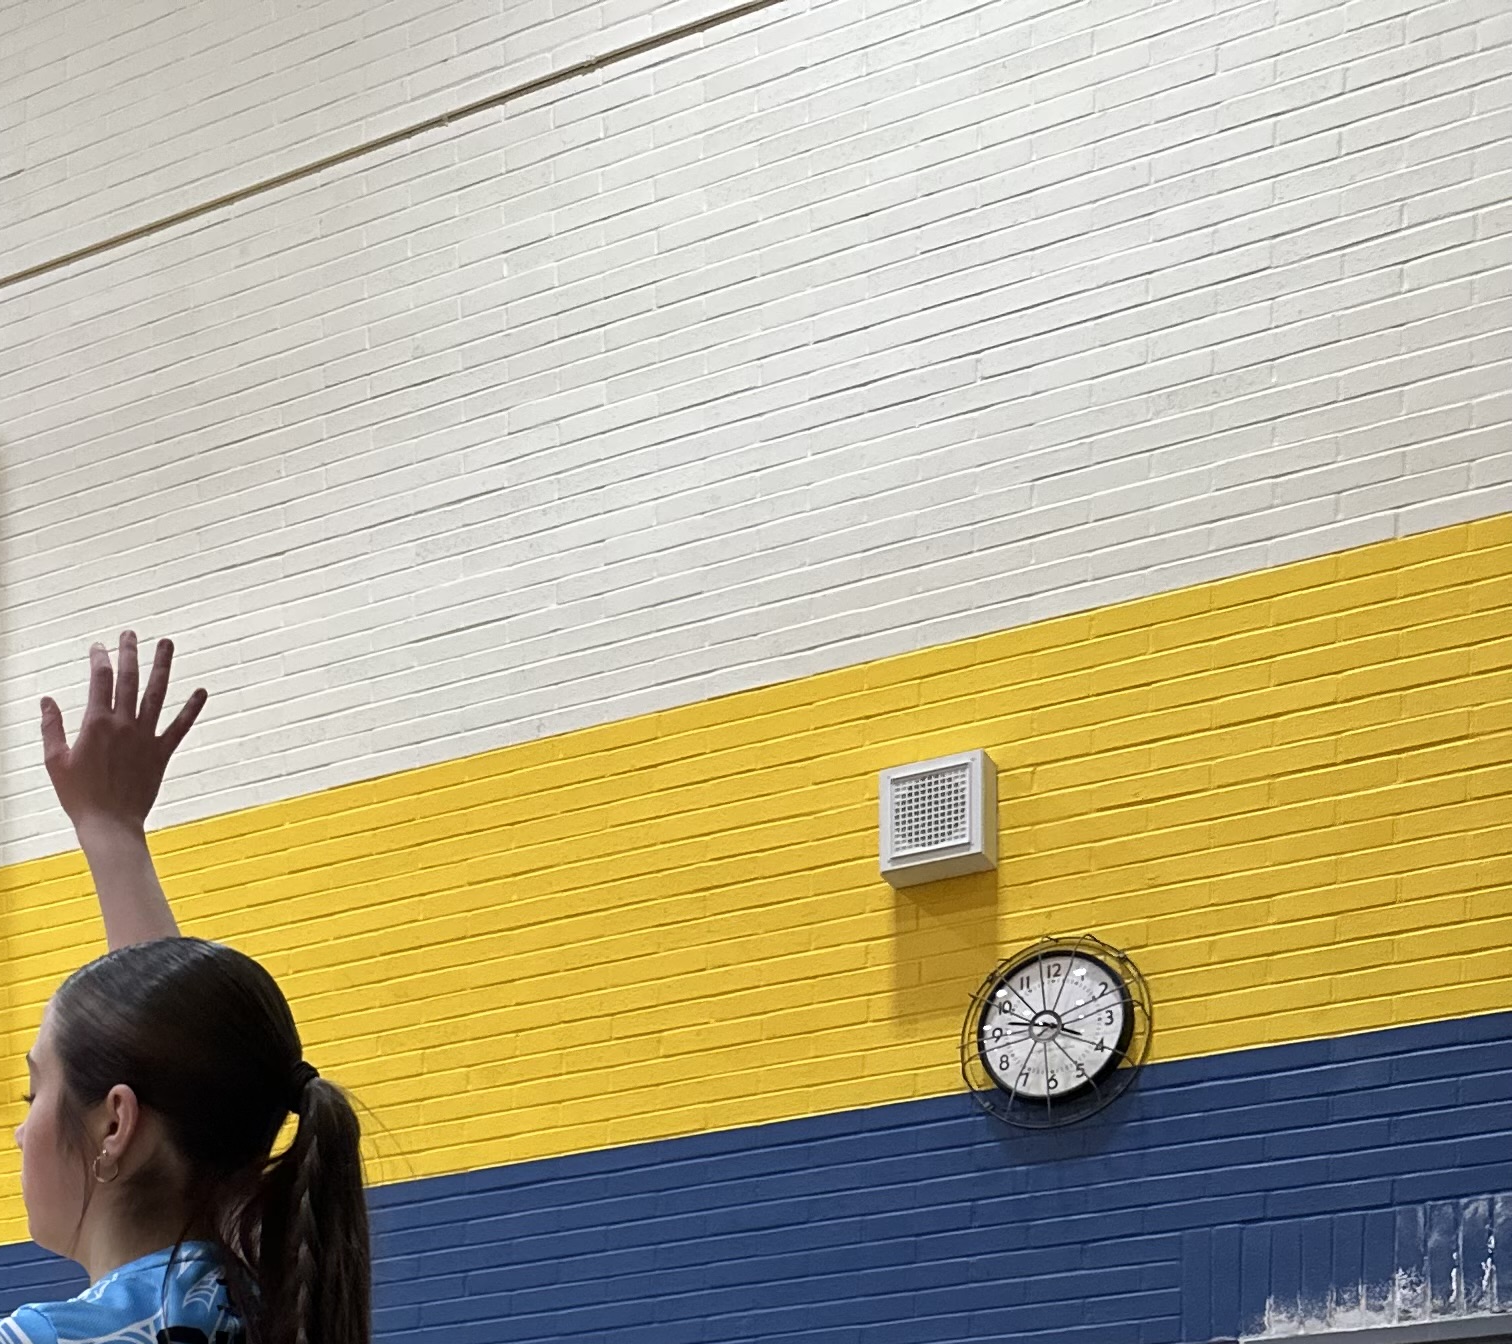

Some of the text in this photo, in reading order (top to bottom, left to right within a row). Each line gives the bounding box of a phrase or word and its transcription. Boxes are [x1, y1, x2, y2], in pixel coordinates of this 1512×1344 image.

[1047, 963, 1062, 979] 12
[1020, 976, 1031, 991] 11
[1098, 981, 1109, 999] 2
[998, 1000, 1013, 1016] 10
[1105, 1010, 1115, 1026] 3
[992, 1027, 1004, 1043] 9
[1093, 1038, 1105, 1053] 4
[999, 1054, 1010, 1071] 8
[1075, 1063, 1086, 1079] 5
[1019, 1072, 1029, 1088] 7
[1048, 1073, 1058, 1090] 6
